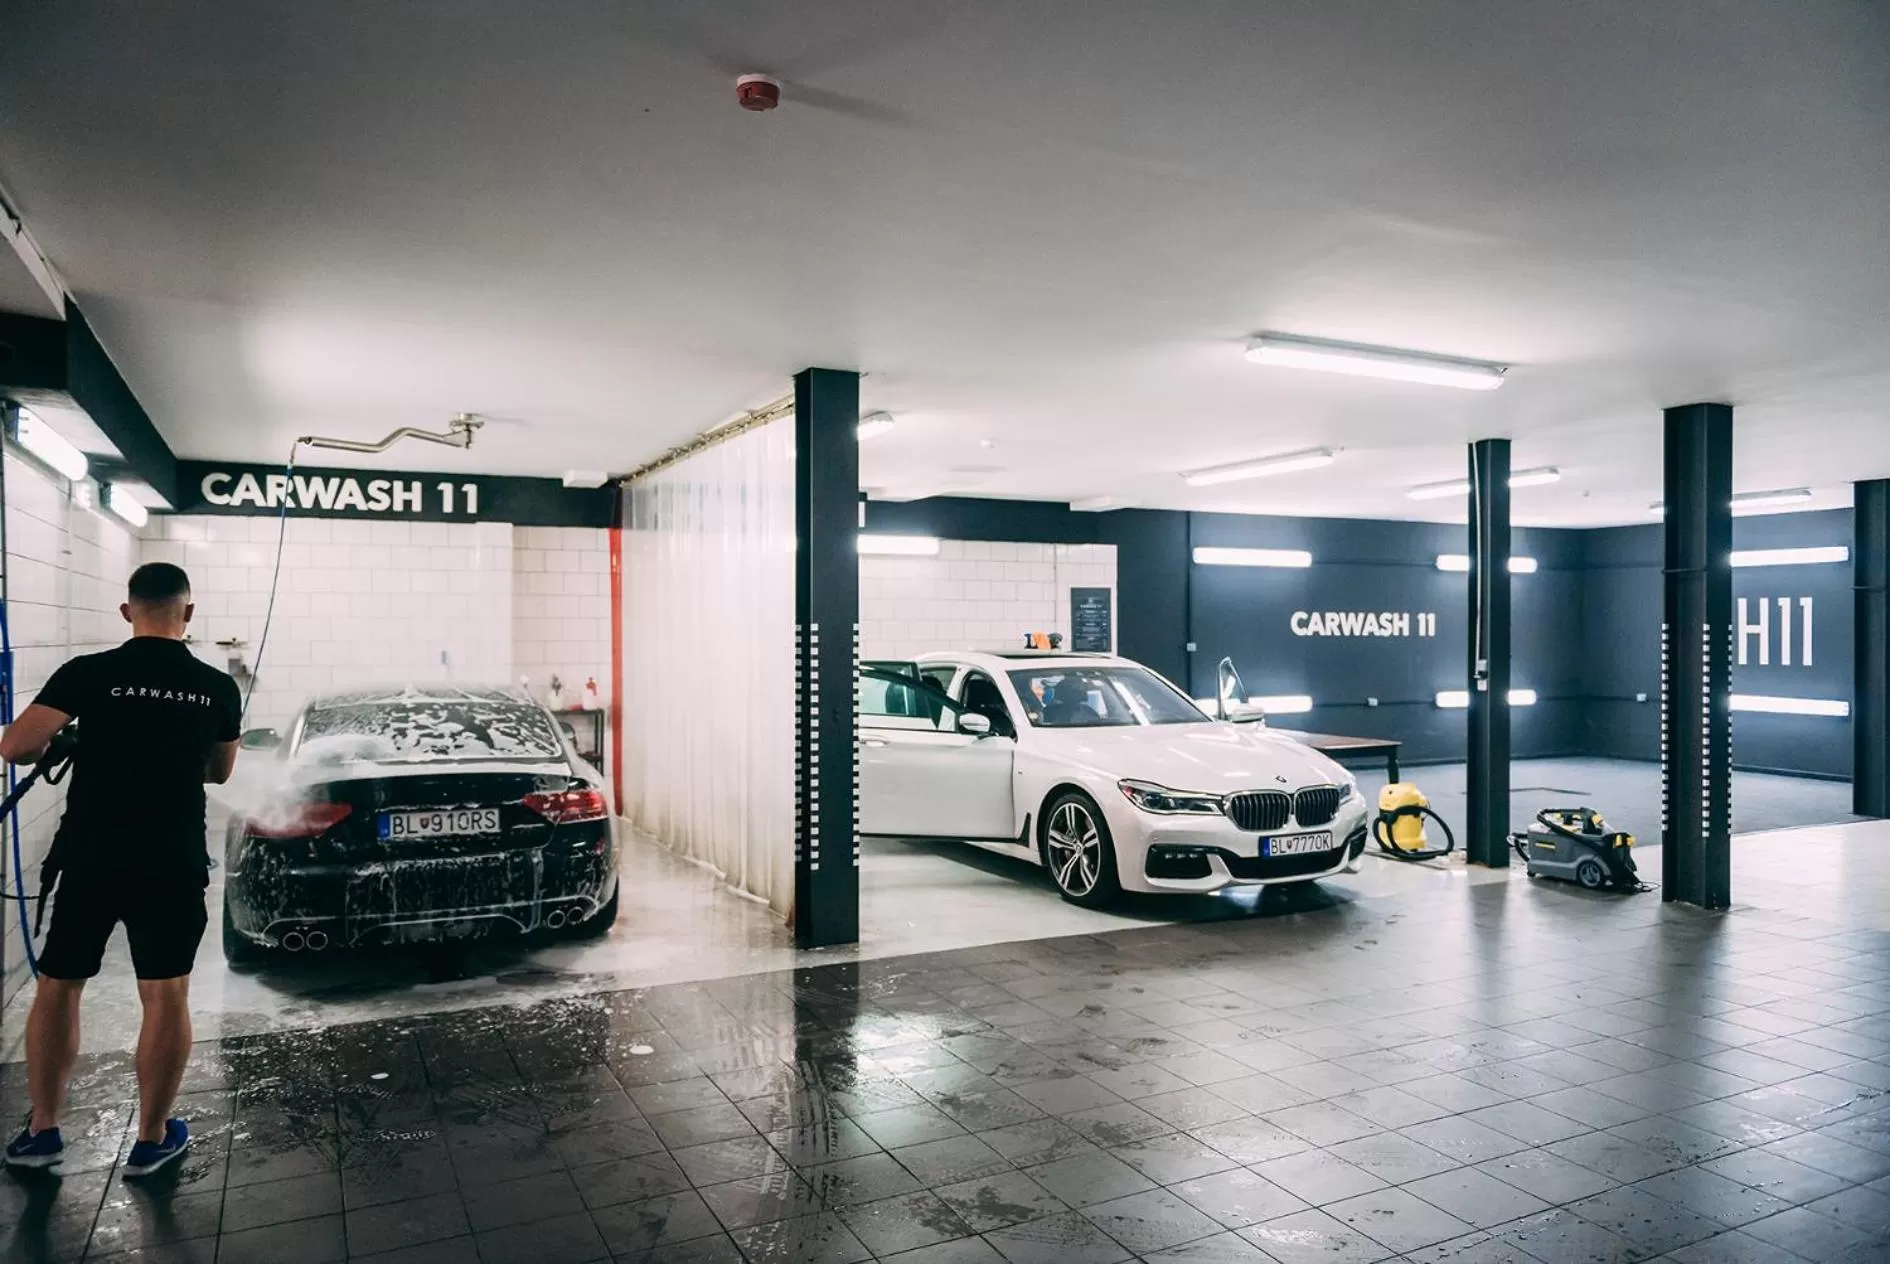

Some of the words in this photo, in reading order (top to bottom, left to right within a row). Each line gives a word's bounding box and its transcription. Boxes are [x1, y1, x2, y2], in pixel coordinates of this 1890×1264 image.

[201, 472, 422, 513] CARWASH
[437, 482, 478, 514] 11
[1290, 611, 1410, 637] CARWASH
[1417, 612, 1437, 637] 11
